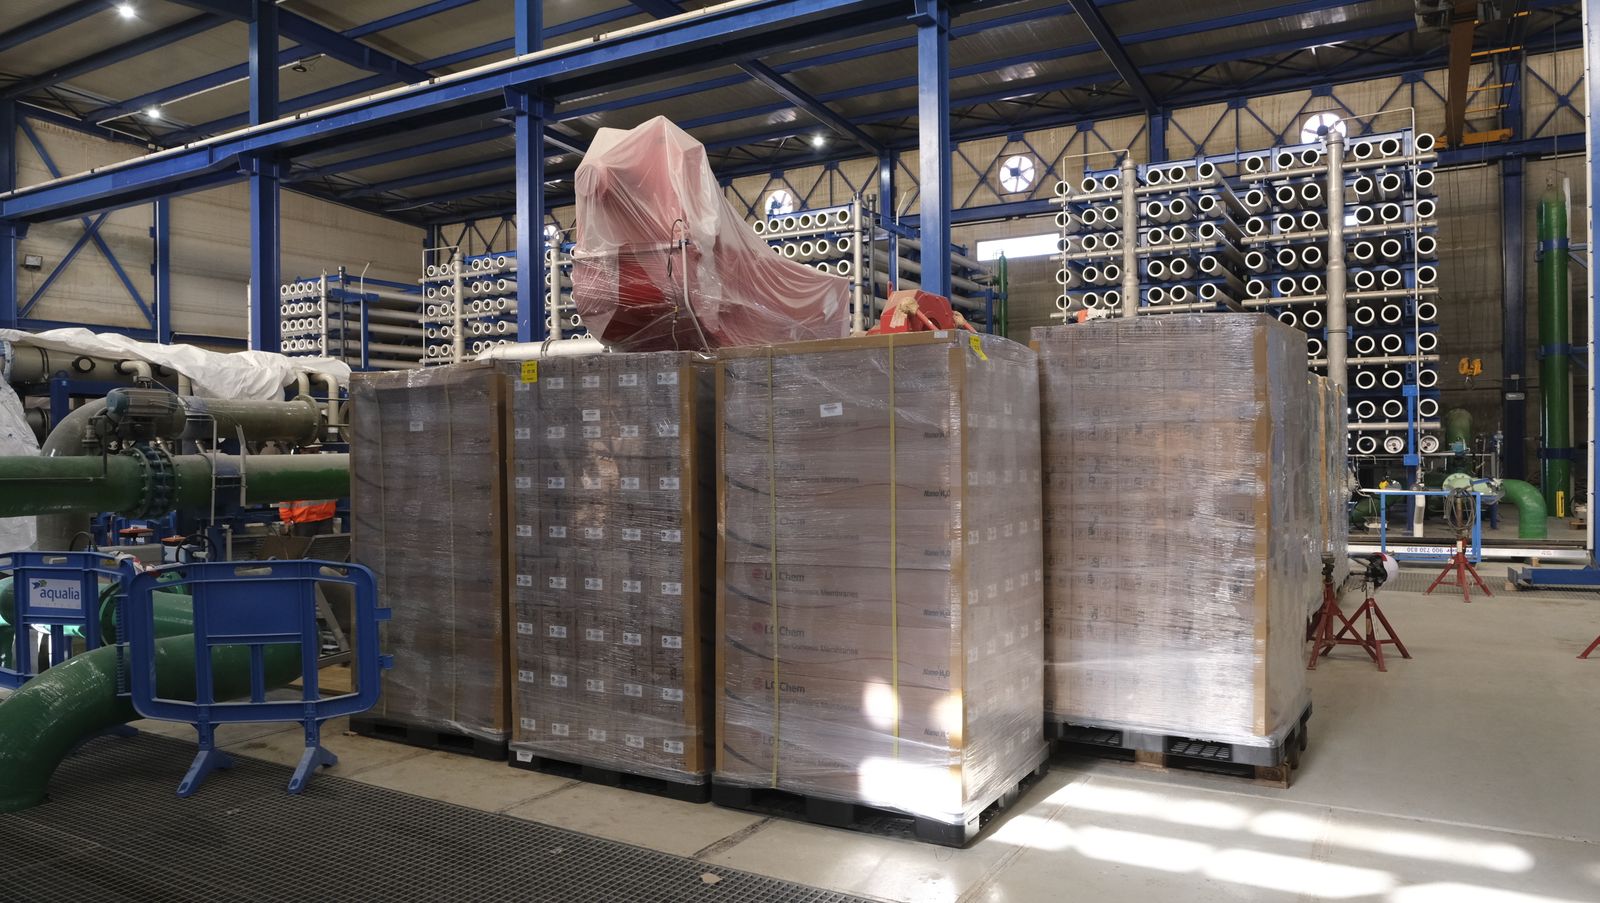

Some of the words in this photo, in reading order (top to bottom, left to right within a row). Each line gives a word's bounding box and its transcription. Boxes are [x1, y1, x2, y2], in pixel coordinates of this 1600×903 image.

[778, 570, 805, 582] Chem
[40, 586, 80, 602] aqualia
[779, 625, 805, 637] Chem
[779, 681, 806, 693] Chem
